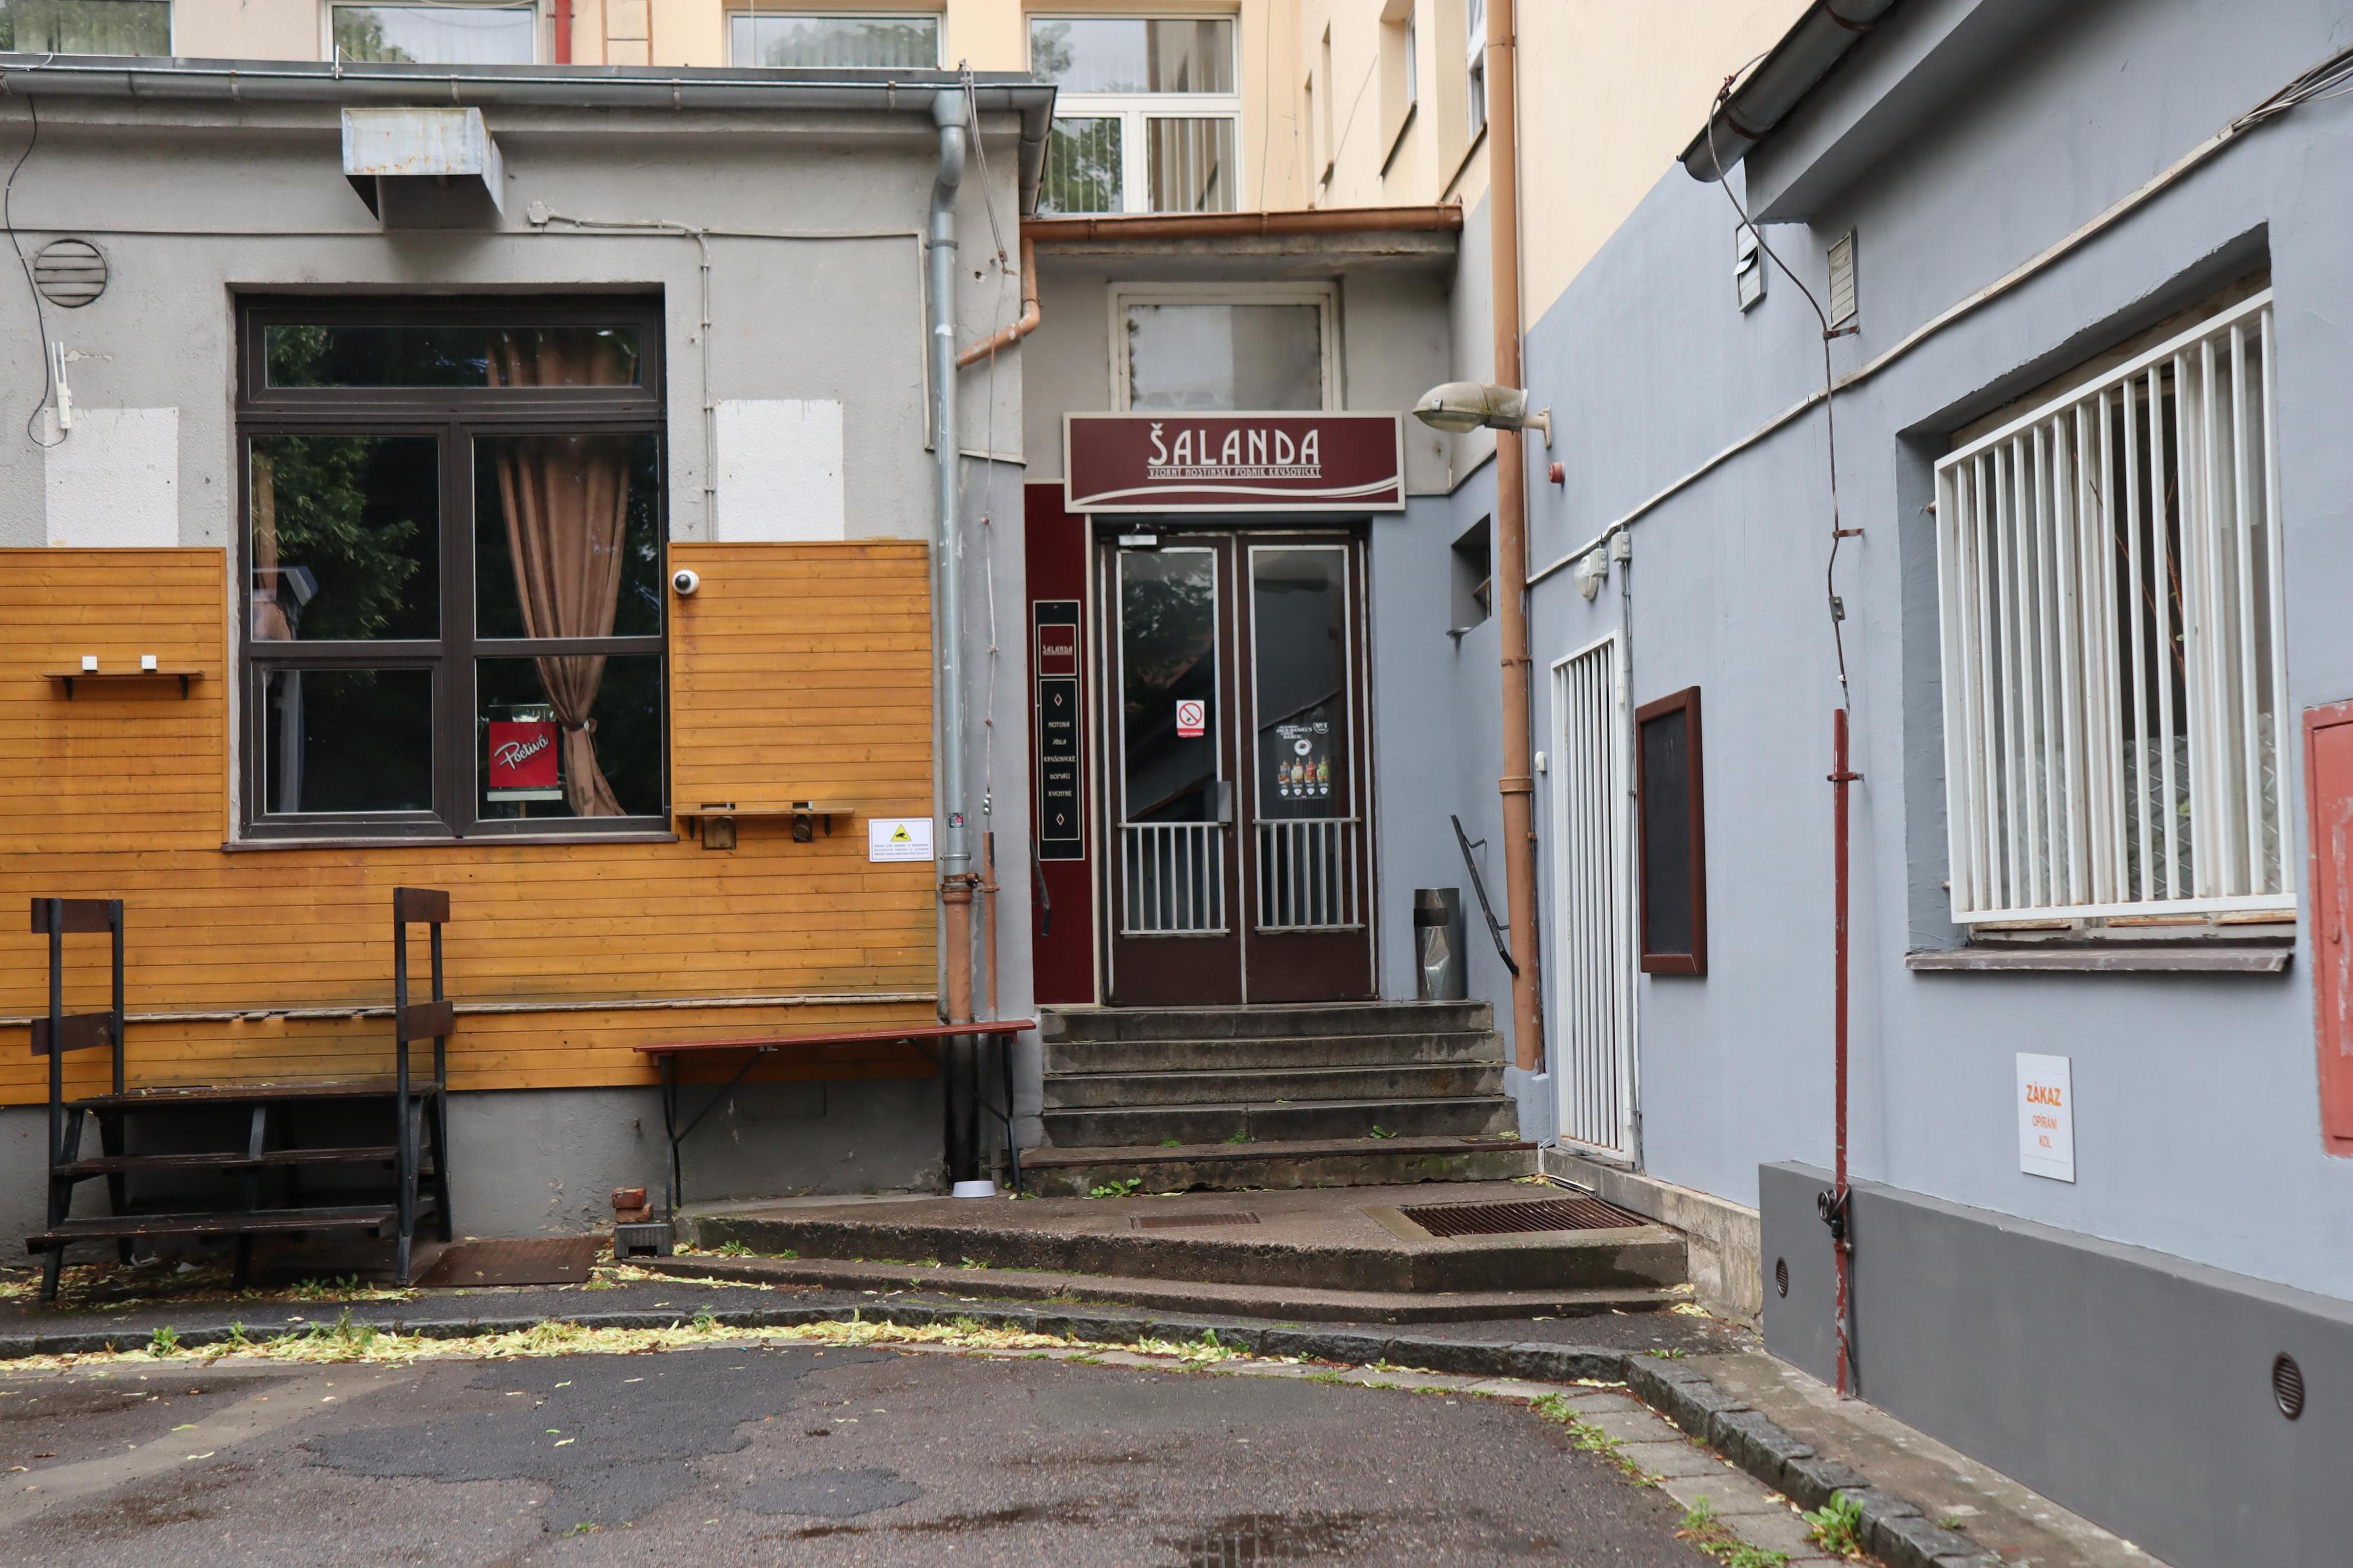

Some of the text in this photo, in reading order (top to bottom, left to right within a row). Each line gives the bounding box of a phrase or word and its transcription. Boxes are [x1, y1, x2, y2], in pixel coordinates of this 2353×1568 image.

[1147, 423, 1319, 465] ŠALANDA
[1235, 468, 1265, 476] PODNIK
[494, 735, 549, 770] Poctivá
[2027, 1080, 2061, 1106] ZÁKAZ
[2038, 1135, 2052, 1148] KOL
